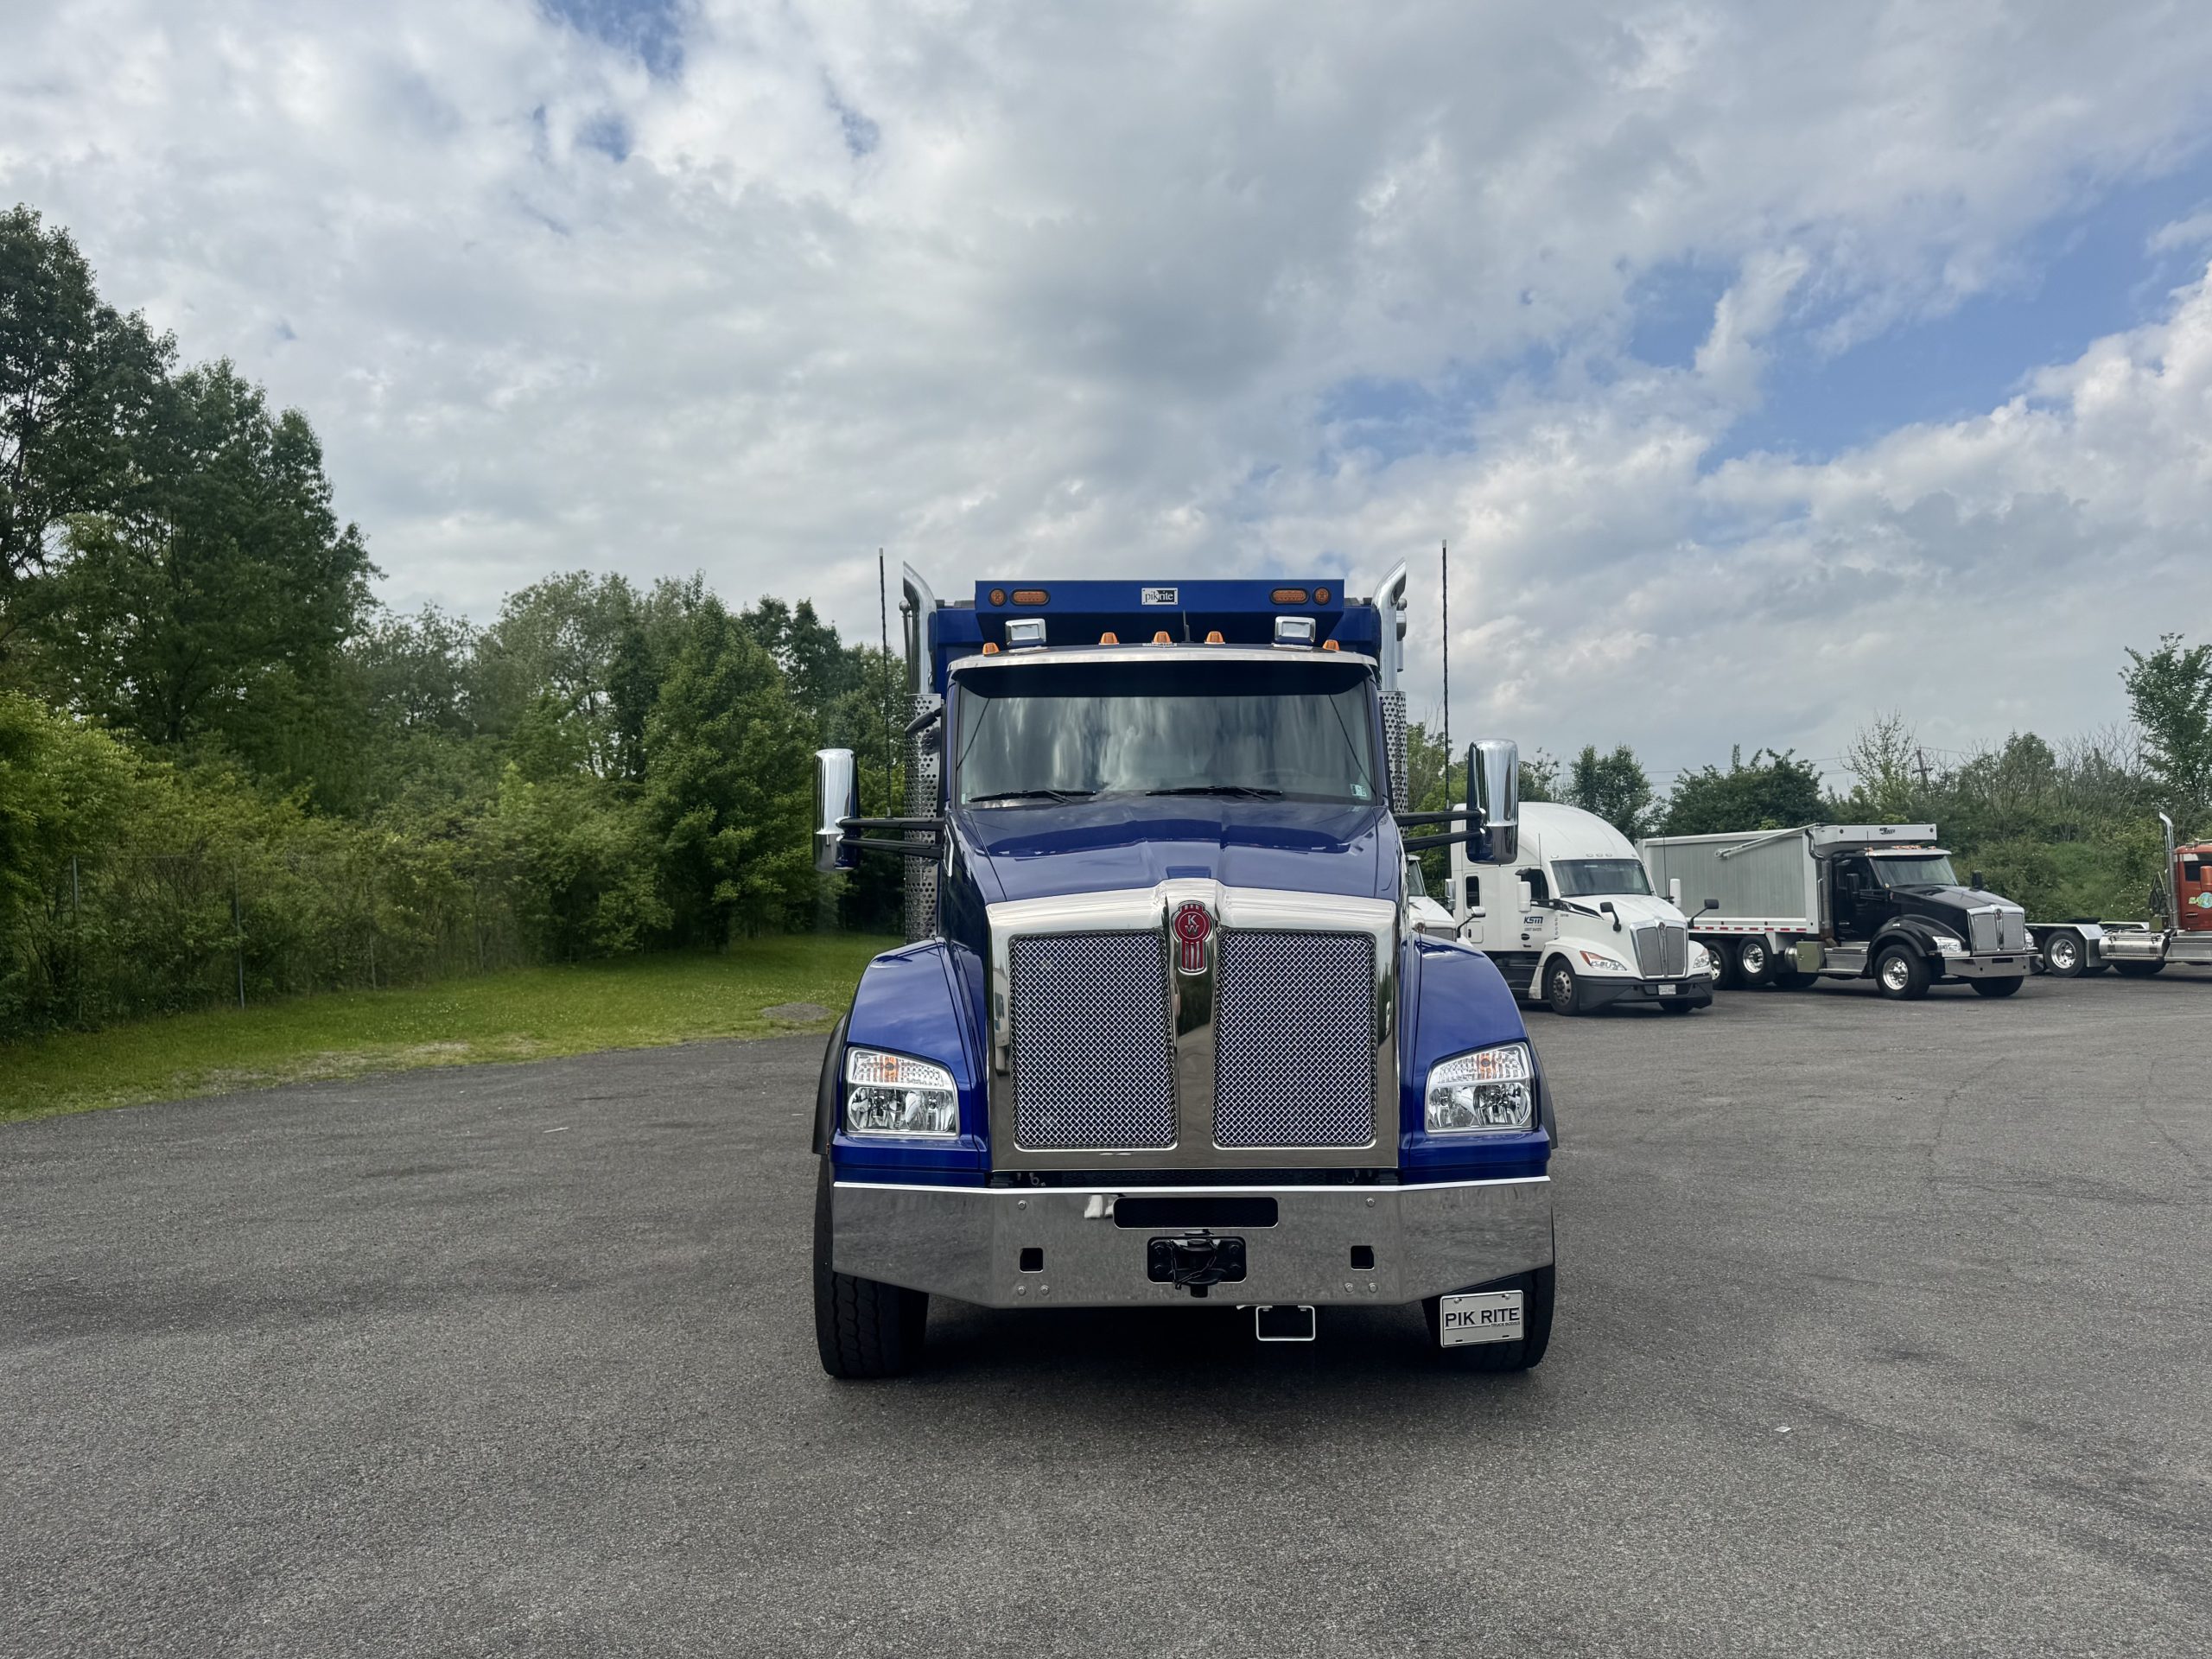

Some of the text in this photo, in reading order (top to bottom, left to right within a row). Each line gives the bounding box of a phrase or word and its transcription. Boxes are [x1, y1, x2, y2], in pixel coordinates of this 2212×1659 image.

[1187, 914, 1197, 925] K
[1185, 925, 1199, 934] W
[1445, 1307, 1520, 1327] PIK RITE
